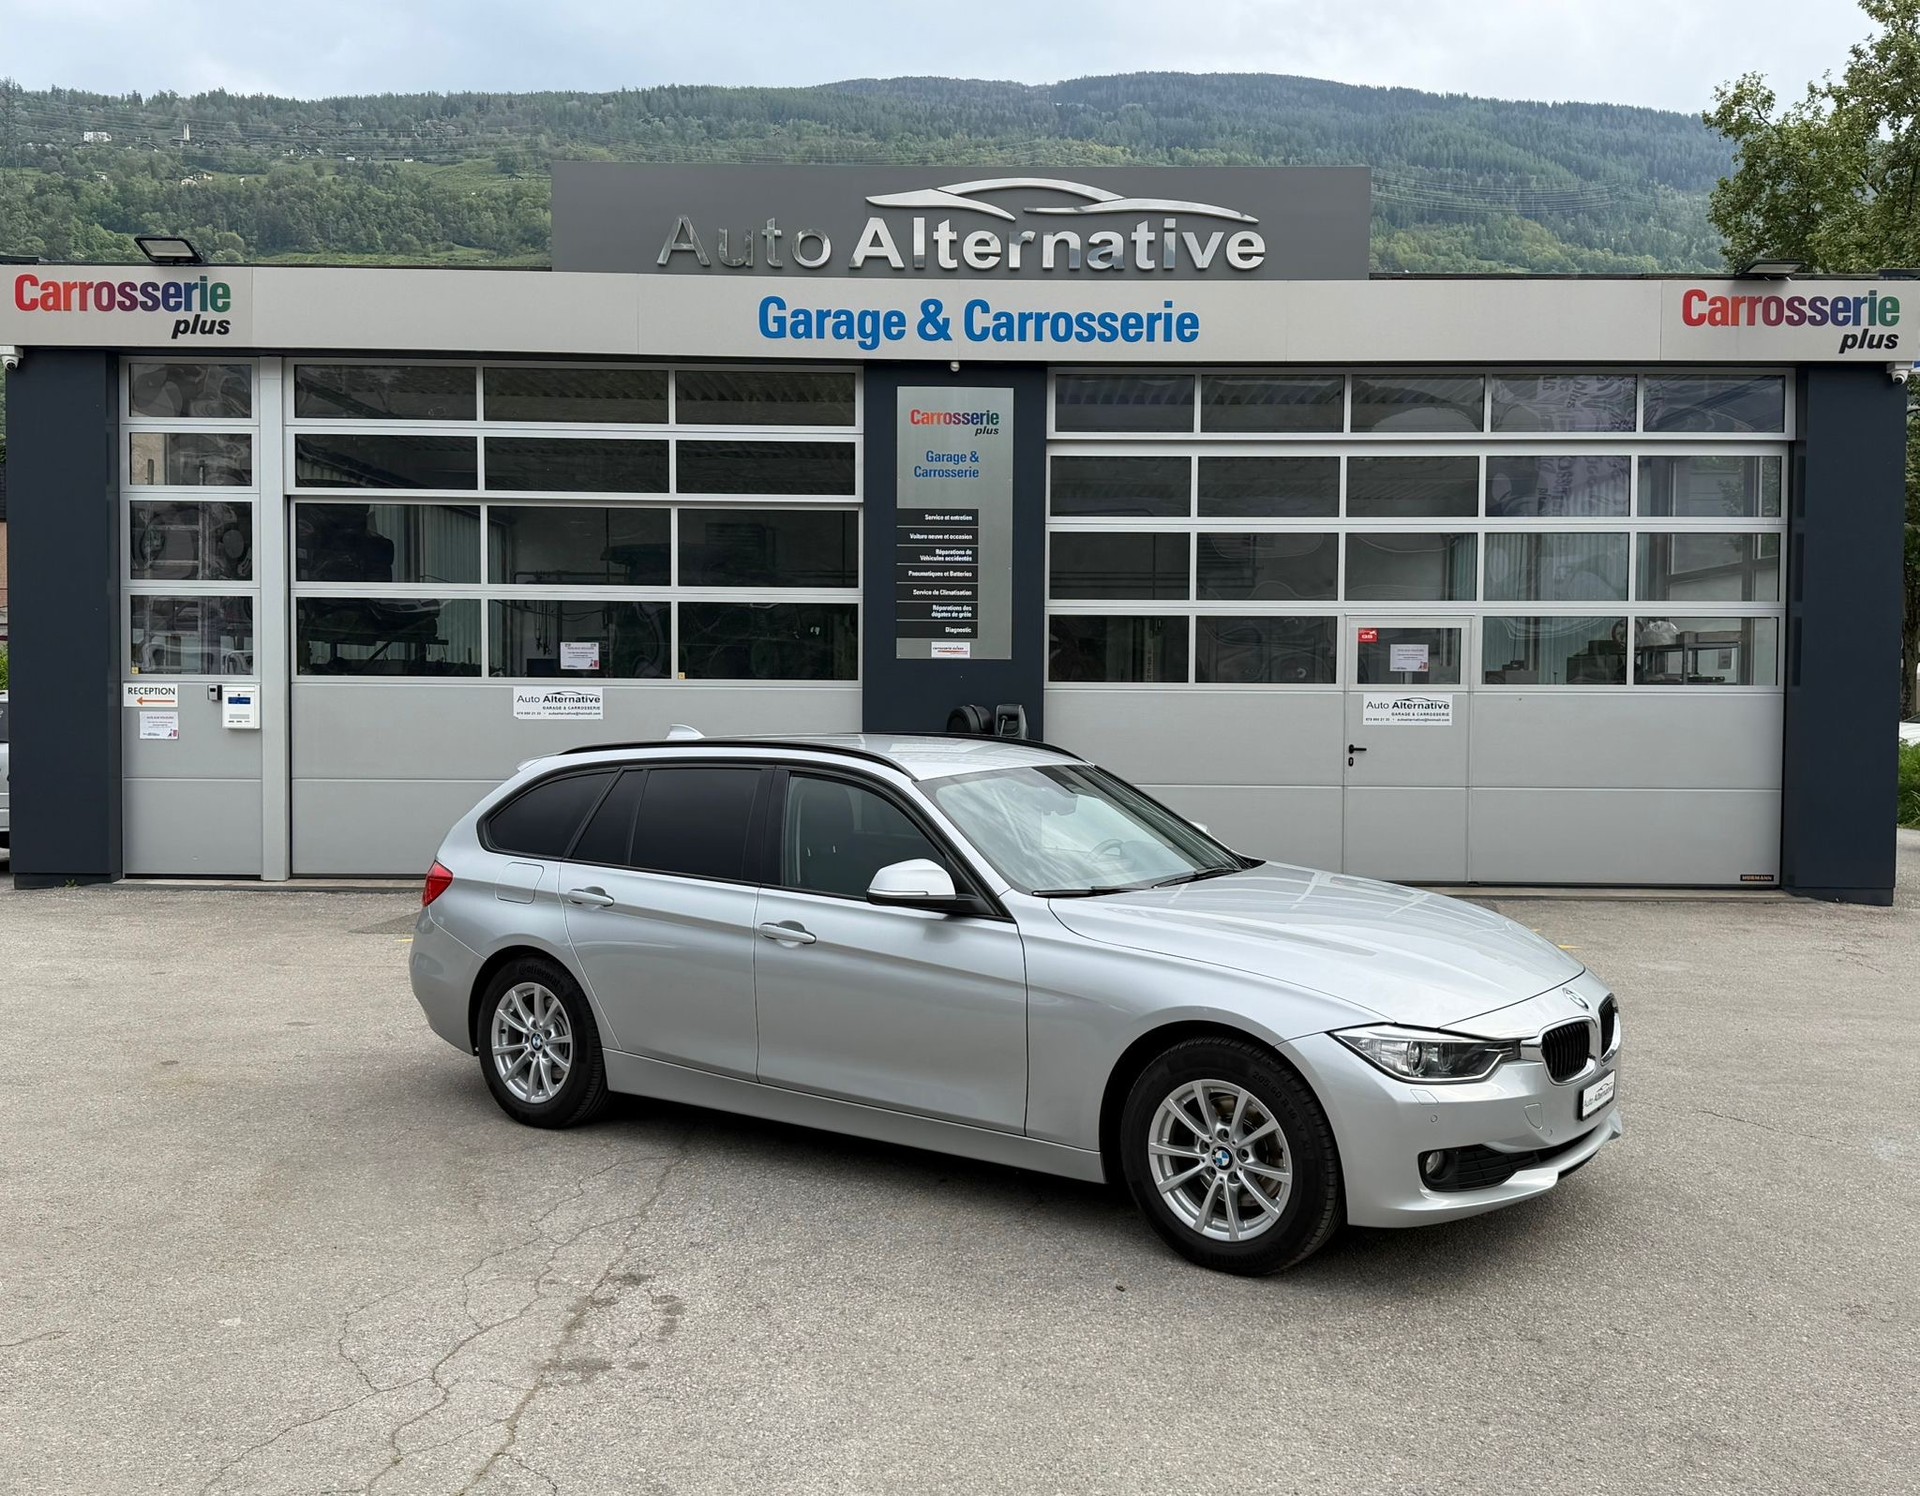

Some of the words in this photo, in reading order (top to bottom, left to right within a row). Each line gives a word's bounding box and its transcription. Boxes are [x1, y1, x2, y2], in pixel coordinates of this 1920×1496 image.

[656, 215, 832, 268] Auto
[848, 217, 1266, 271] Alternative
[15, 274, 231, 313] Carrosserie
[1682, 289, 1900, 327] Carrosserie
[171, 314, 231, 339] plus
[758, 295, 906, 351] Garage
[917, 298, 953, 342] &
[964, 298, 1200, 343] Carrosserie
[1838, 328, 1899, 354] plus
[910, 409, 1000, 425] Carrosserie
[974, 426, 999, 436] plus
[926, 450, 967, 465] Garage
[969, 450, 980, 462] &
[914, 466, 979, 478] Carrosserie
[127, 687, 176, 695] RECEPTION
[516, 695, 540, 703] Auto
[542, 695, 601, 703] Alternative
[1366, 701, 1389, 709] Auto
[1391, 701, 1450, 709] Alternative
